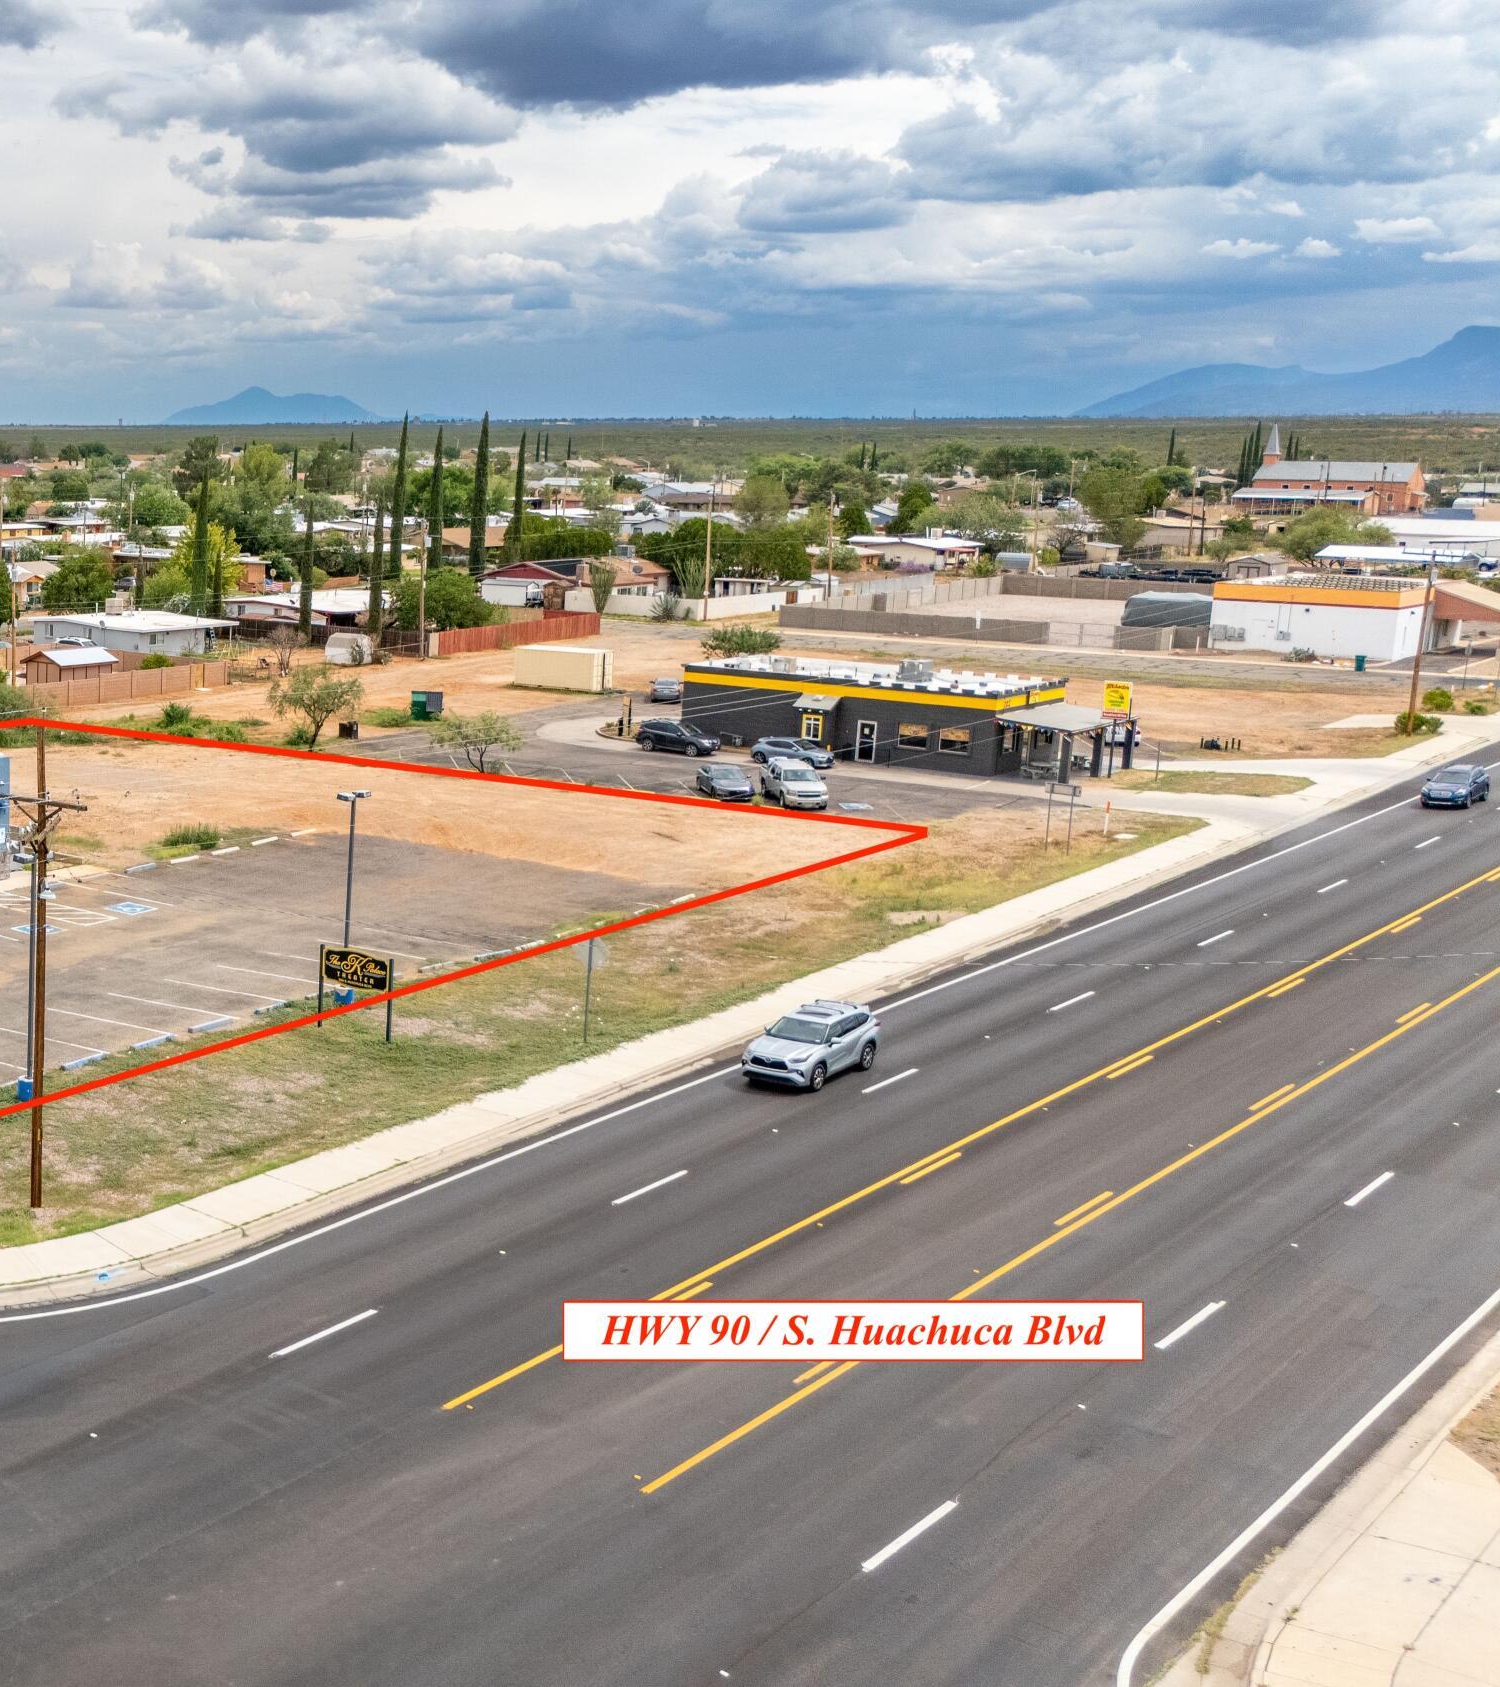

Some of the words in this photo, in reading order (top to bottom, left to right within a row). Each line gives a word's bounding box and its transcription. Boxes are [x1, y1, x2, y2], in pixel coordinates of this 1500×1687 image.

[328, 954, 341, 966] The
[341, 954, 372, 975] K
[364, 962, 387, 975] Palace
[337, 970, 375, 985] THEATER
